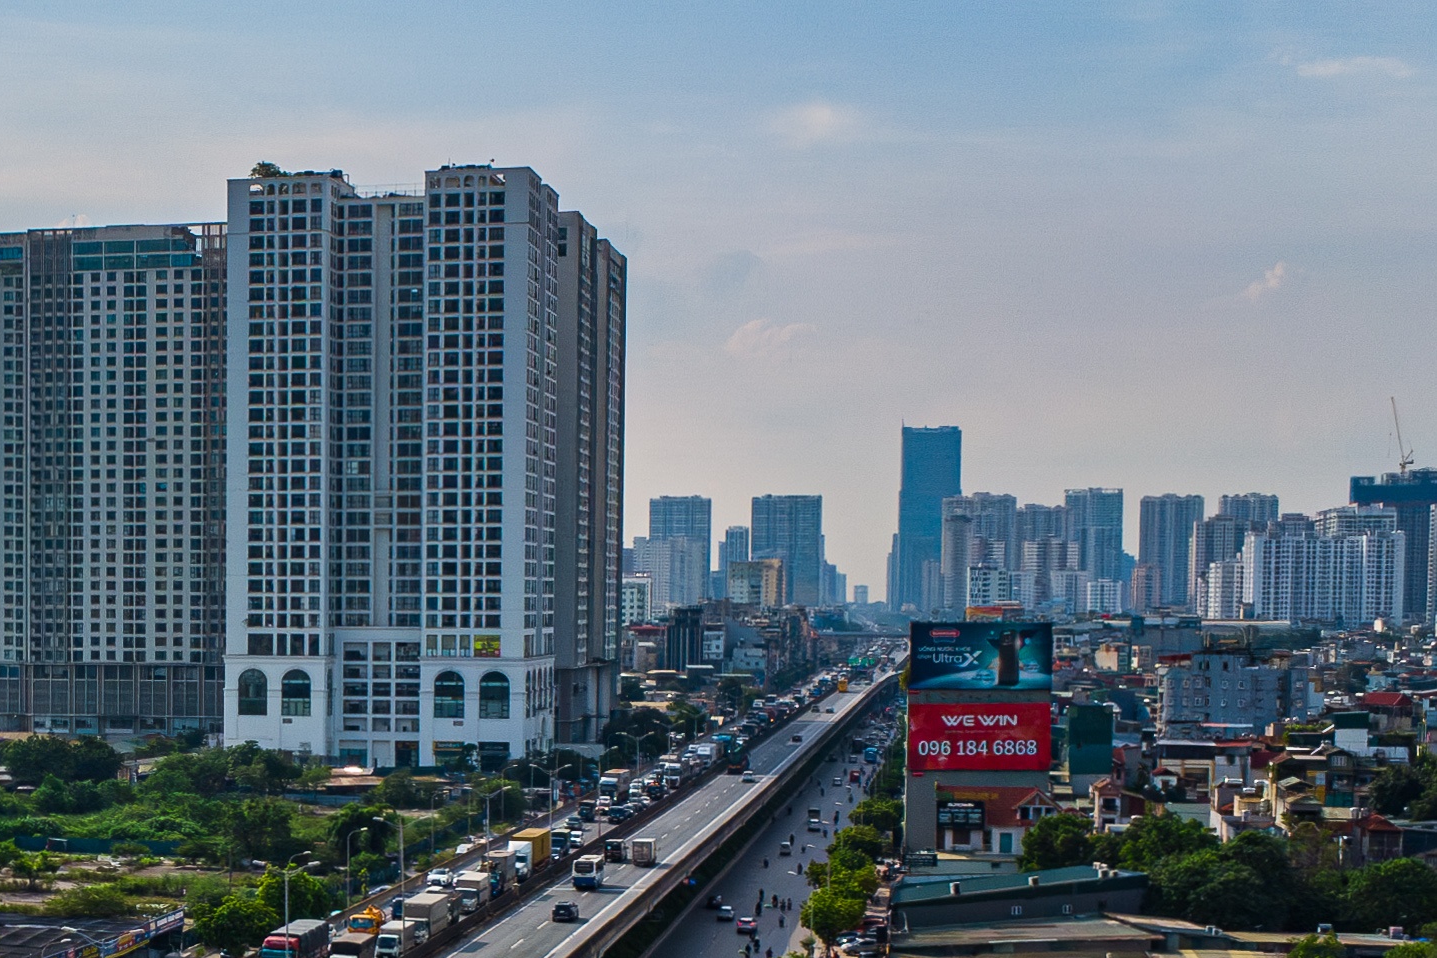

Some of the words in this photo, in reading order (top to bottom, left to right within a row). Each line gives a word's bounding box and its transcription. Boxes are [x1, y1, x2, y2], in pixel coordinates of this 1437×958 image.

[941, 714, 975, 726] WE
[977, 714, 1017, 726] WIN
[918, 740, 951, 756] 096
[957, 740, 988, 756] 184
[993, 740, 1037, 756] 6868
